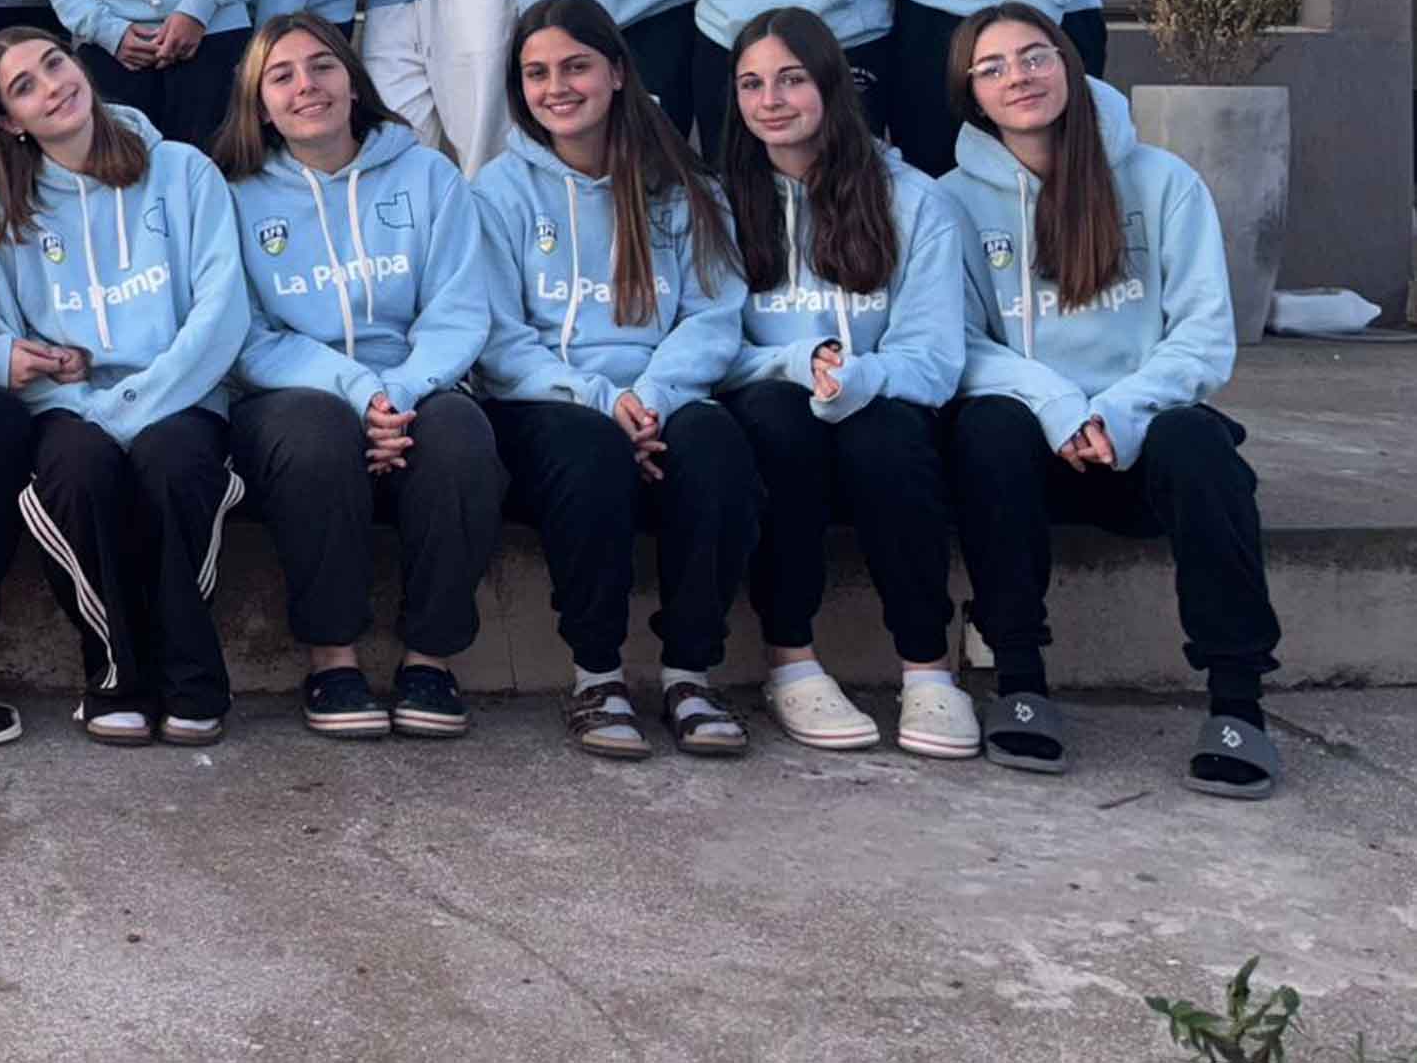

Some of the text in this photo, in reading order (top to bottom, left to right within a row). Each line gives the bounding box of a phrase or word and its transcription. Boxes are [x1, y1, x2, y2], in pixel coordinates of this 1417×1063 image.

[272, 253, 410, 295] La Pampa
[537, 272, 569, 299] La
[52, 282, 84, 313] La
[753, 286, 888, 318] La Pampa
